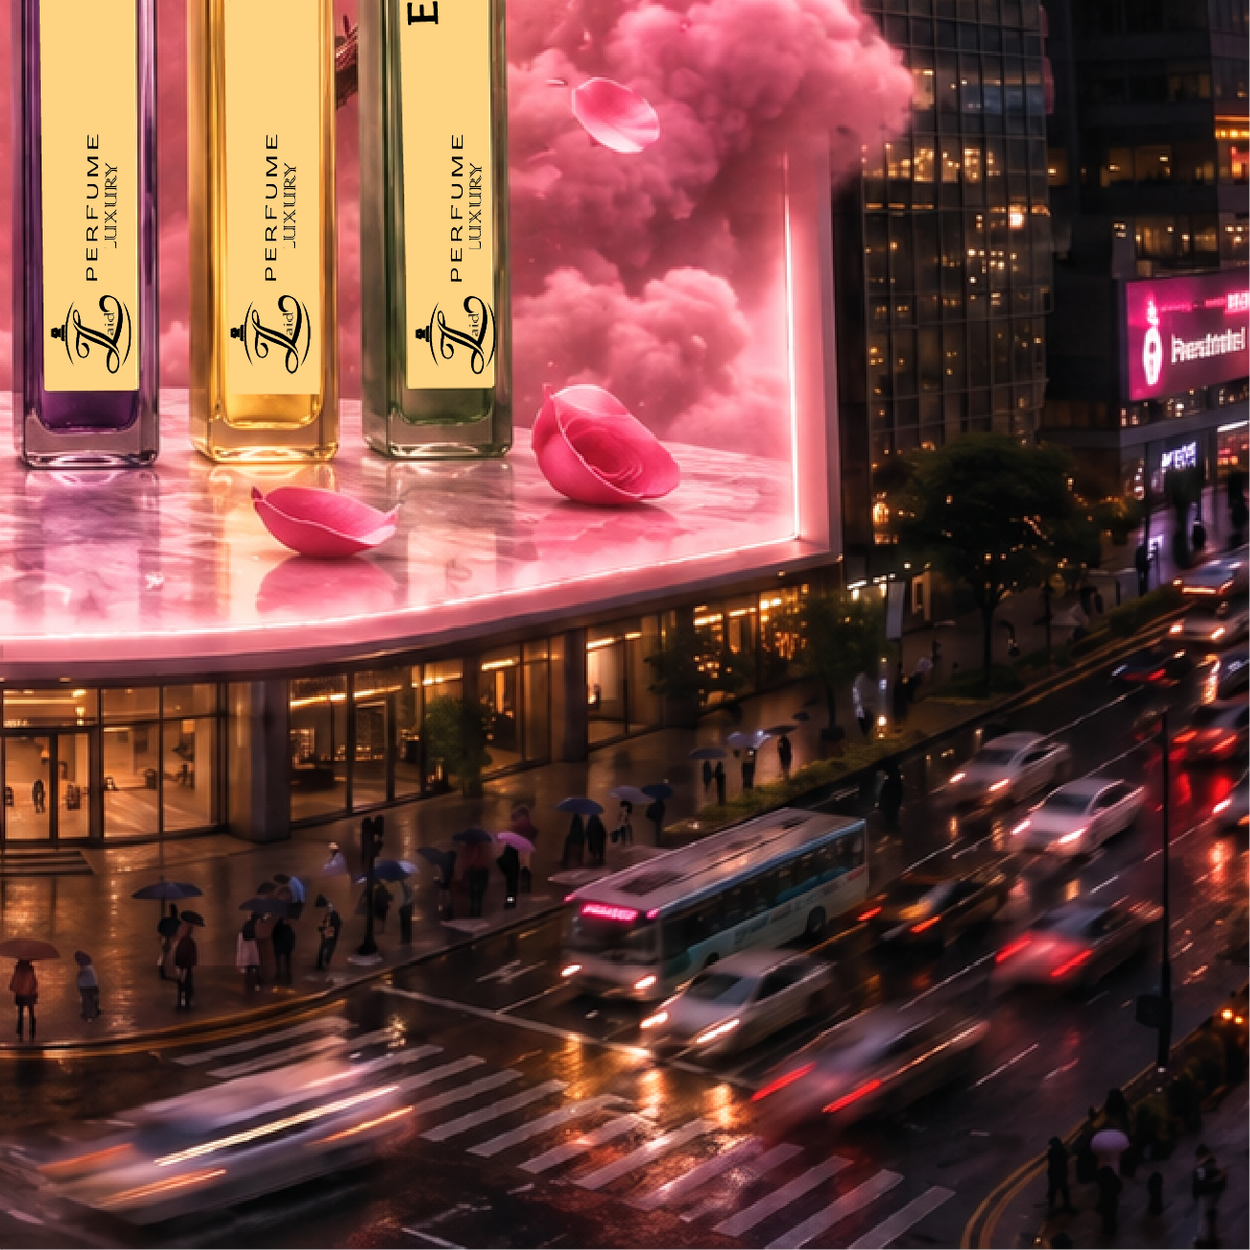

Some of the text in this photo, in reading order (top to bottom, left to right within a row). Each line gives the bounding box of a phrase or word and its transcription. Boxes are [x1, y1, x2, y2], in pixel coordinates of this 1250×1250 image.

[85, 134, 99, 282] PERFUME
[264, 134, 278, 282] PERFUME
[450, 134, 464, 283] PERFUME
